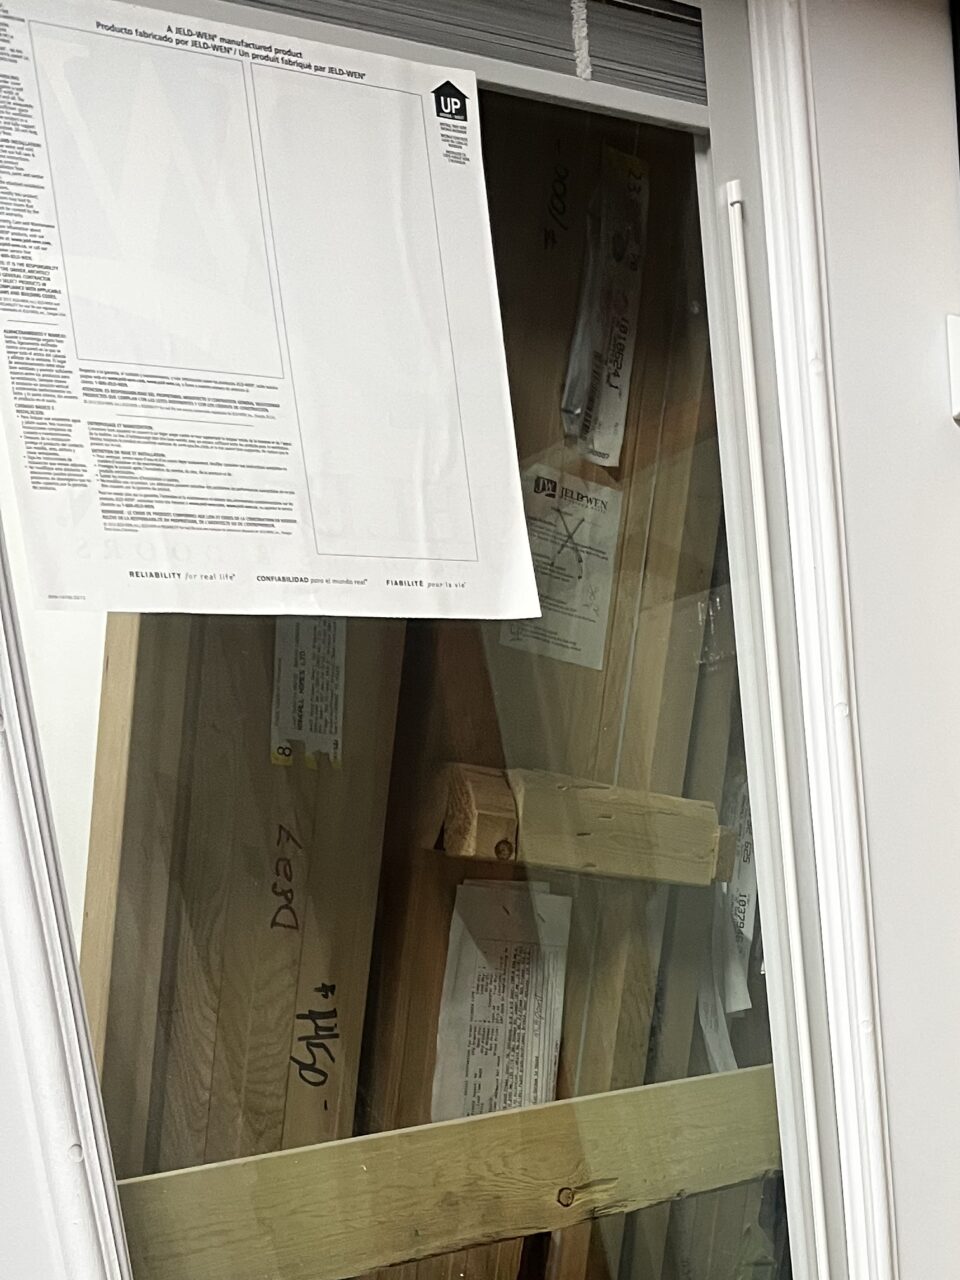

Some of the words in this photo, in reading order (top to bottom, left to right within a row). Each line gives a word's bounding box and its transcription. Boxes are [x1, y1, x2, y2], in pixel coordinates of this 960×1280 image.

[96, 21, 133, 36] Producto
[135, 28, 173, 43] fabricado
[274, 46, 303, 59] product
[440, 96, 461, 114] UP
[129, 571, 182, 579] RELIABILITY
[256, 575, 309, 584] CONFIABILIDAD
